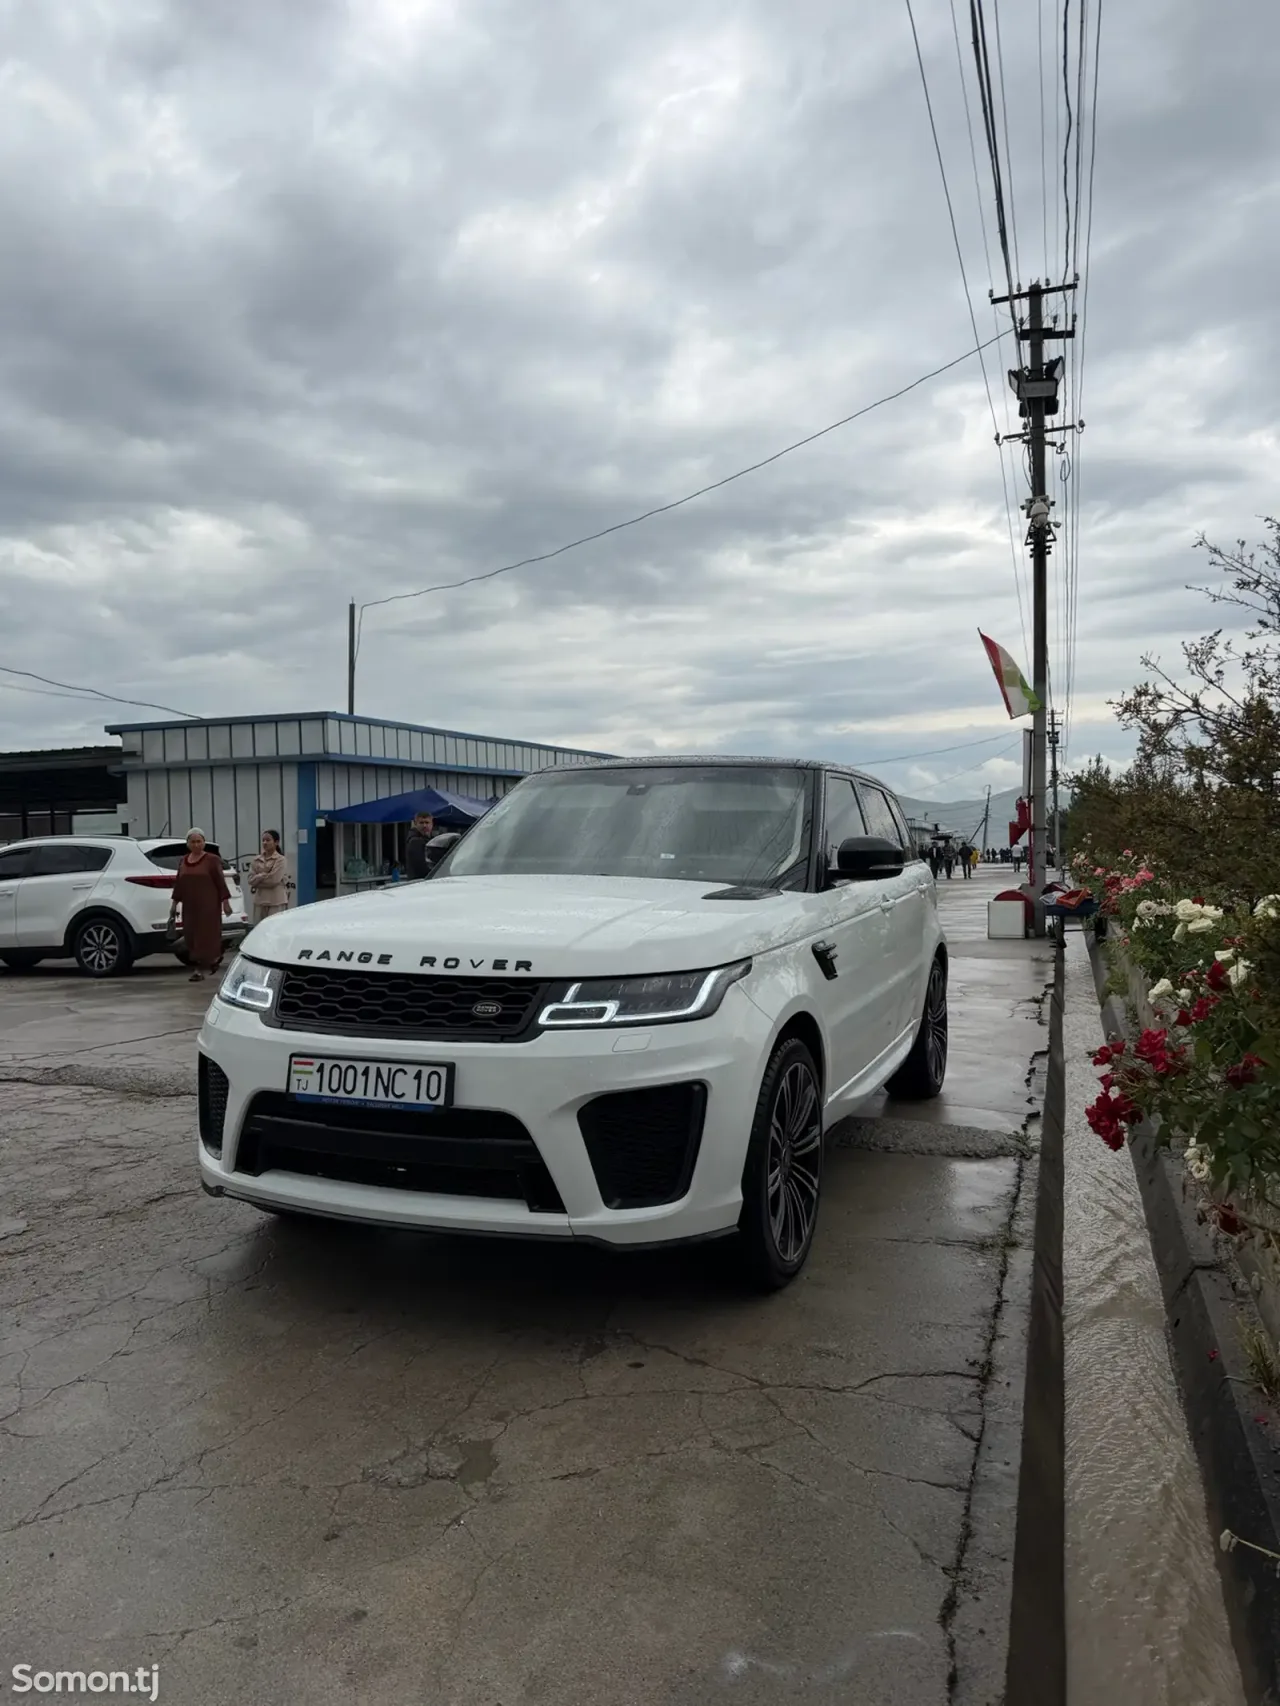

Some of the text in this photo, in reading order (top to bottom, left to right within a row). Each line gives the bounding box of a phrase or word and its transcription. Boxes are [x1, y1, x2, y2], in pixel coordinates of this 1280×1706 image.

[298, 949, 533, 972] RANGE ROVER
[296, 1078, 309, 1091] TJ
